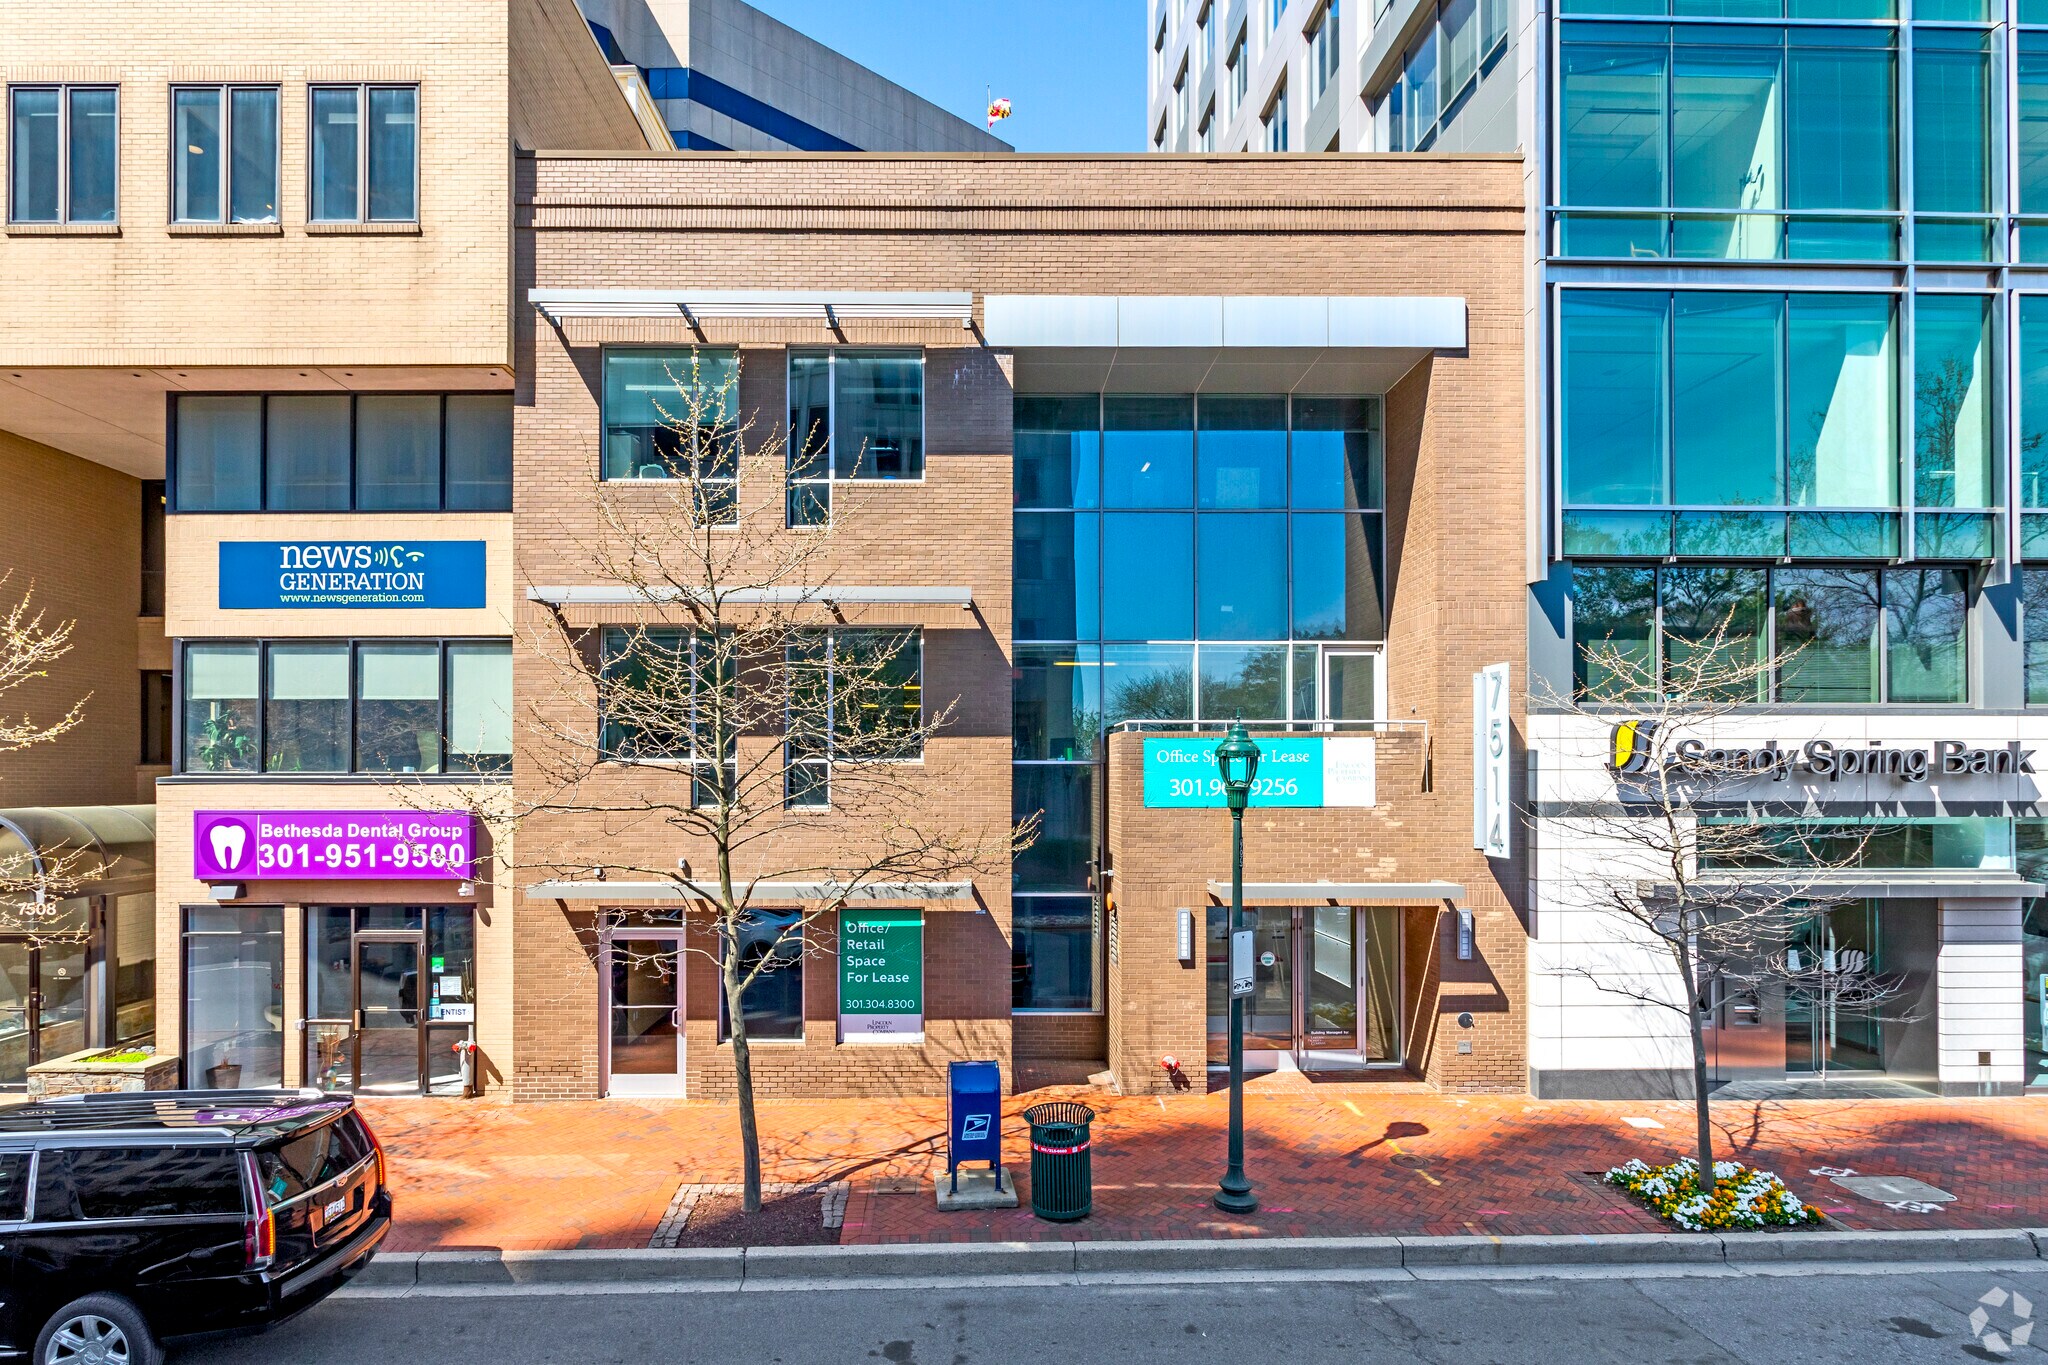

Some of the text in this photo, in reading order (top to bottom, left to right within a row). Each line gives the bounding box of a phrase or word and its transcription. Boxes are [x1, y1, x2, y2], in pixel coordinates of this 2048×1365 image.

[280, 545, 372, 569] news
[280, 572, 424, 591] GENERATION
[280, 592, 424, 604] www.newsgeneration.com
[1156, 749, 1198, 763] Office
[1272, 749, 1310, 763] Lease
[1489, 671, 1504, 853] 7514
[1676, 740, 2037, 782] Sandy Spring Bank
[1169, 778, 1298, 797] 301.99256
[261, 823, 463, 841] Bethesda Dental Group
[259, 843, 465, 869] 301-951-9500
[18, 902, 57, 915] 7508
[846, 922, 891, 934] Office/
[847, 939, 885, 950] Retail
[846, 955, 886, 969] Space
[847, 972, 910, 983] For Lease
[846, 999, 915, 1009] 301.304.8300
[441, 1008, 466, 1016] ENTIST
